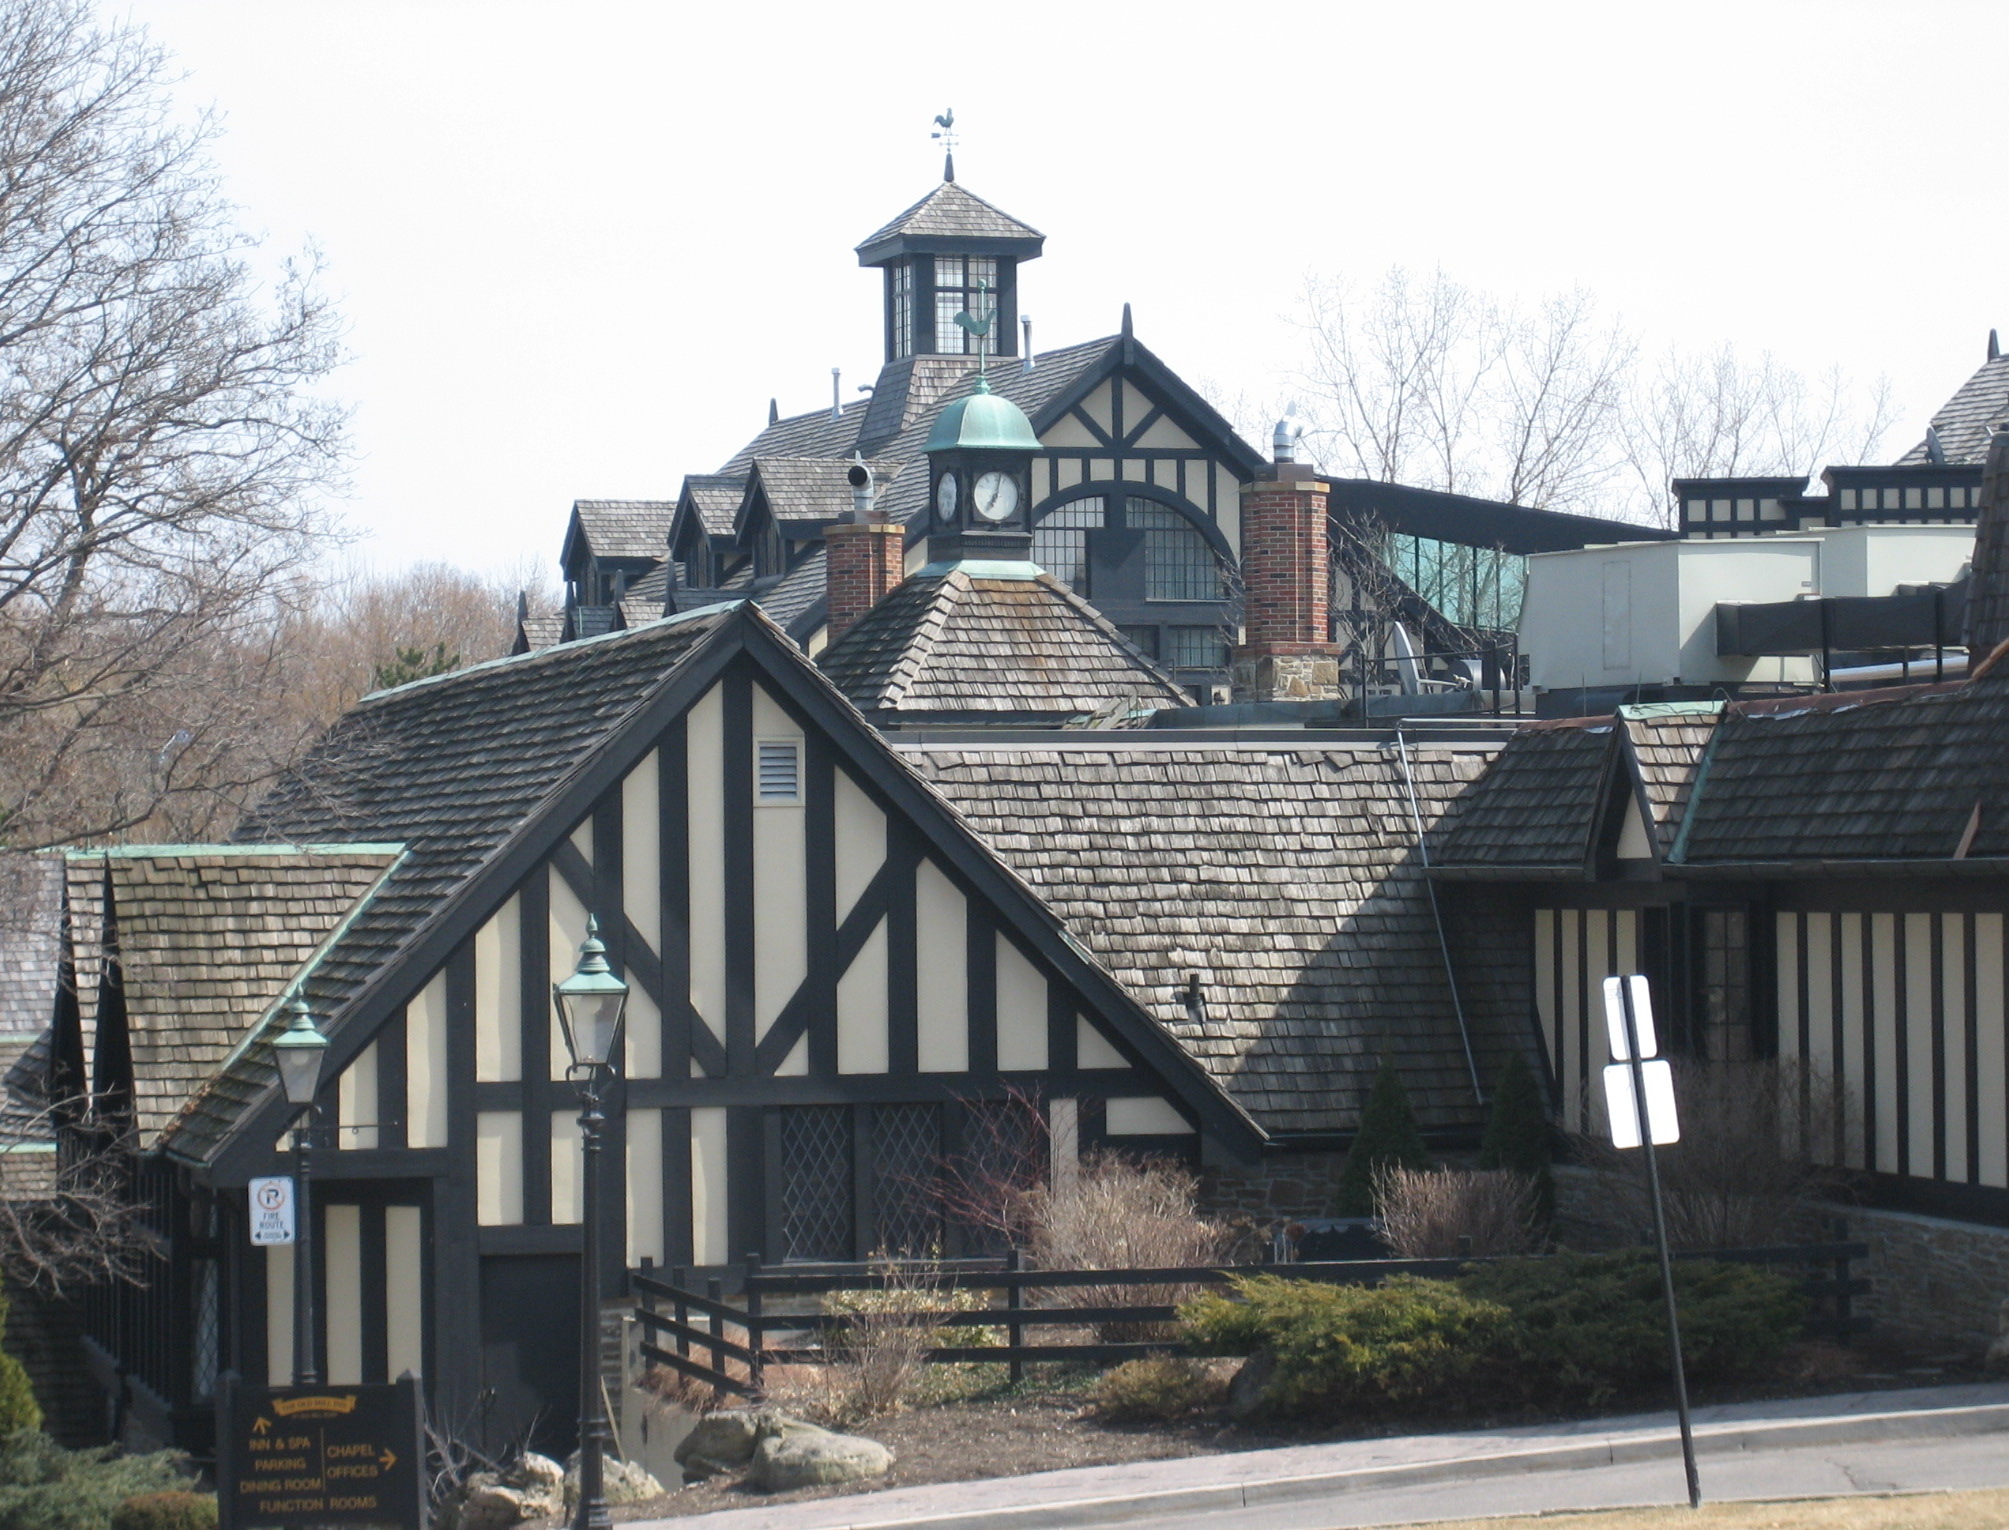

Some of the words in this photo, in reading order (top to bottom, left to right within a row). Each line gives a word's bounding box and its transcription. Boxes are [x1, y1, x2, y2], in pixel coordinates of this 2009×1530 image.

[263, 1212, 280, 1221] FIRE
[259, 1221, 284, 1230] ROUTE
[249, 1438, 270, 1451] INN
[275, 1437, 285, 1450] &
[288, 1436, 311, 1449] SPA
[327, 1444, 376, 1458] CHAPEL
[255, 1458, 306, 1471] PARKING
[327, 1465, 378, 1479] OFFICES
[240, 1480, 282, 1494] DINING
[284, 1478, 321, 1491] ROOM
[259, 1498, 323, 1513] FUNCTION
[329, 1496, 377, 1510] ROOMS
